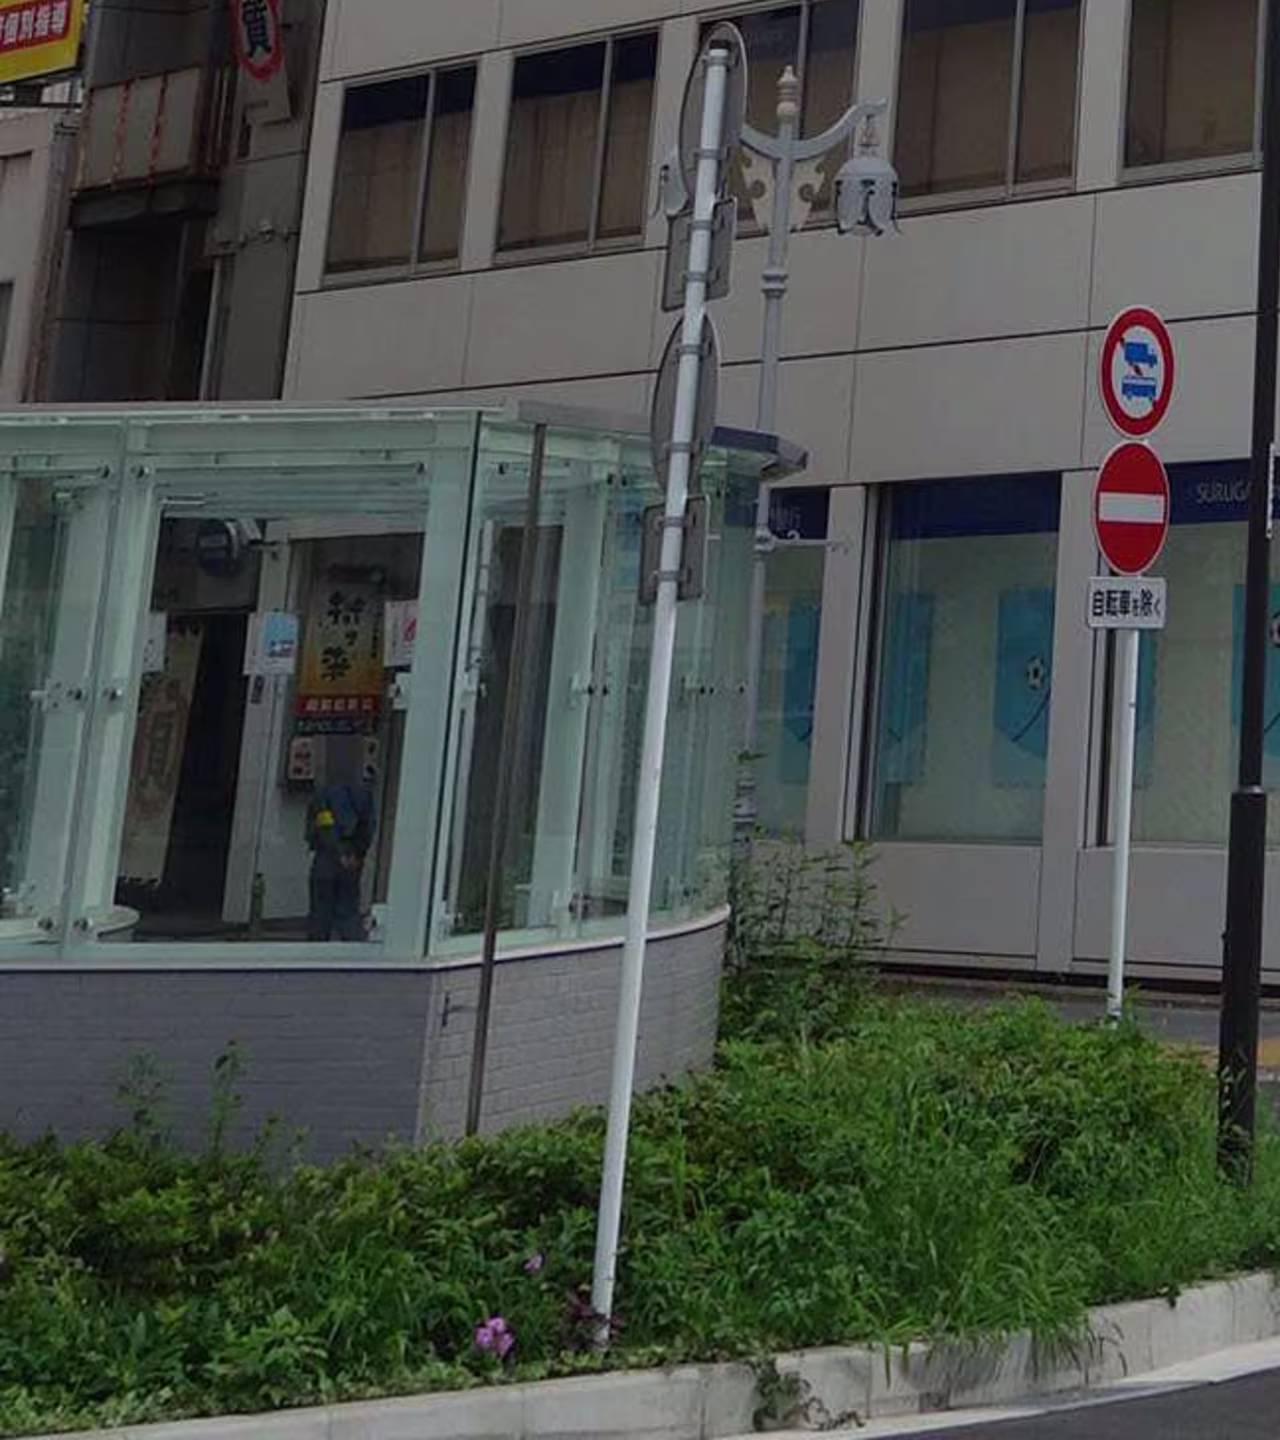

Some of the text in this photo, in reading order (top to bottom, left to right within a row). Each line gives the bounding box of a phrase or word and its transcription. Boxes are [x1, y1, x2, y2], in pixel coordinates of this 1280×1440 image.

[1092, 587, 1161, 617] 自転車を除く
